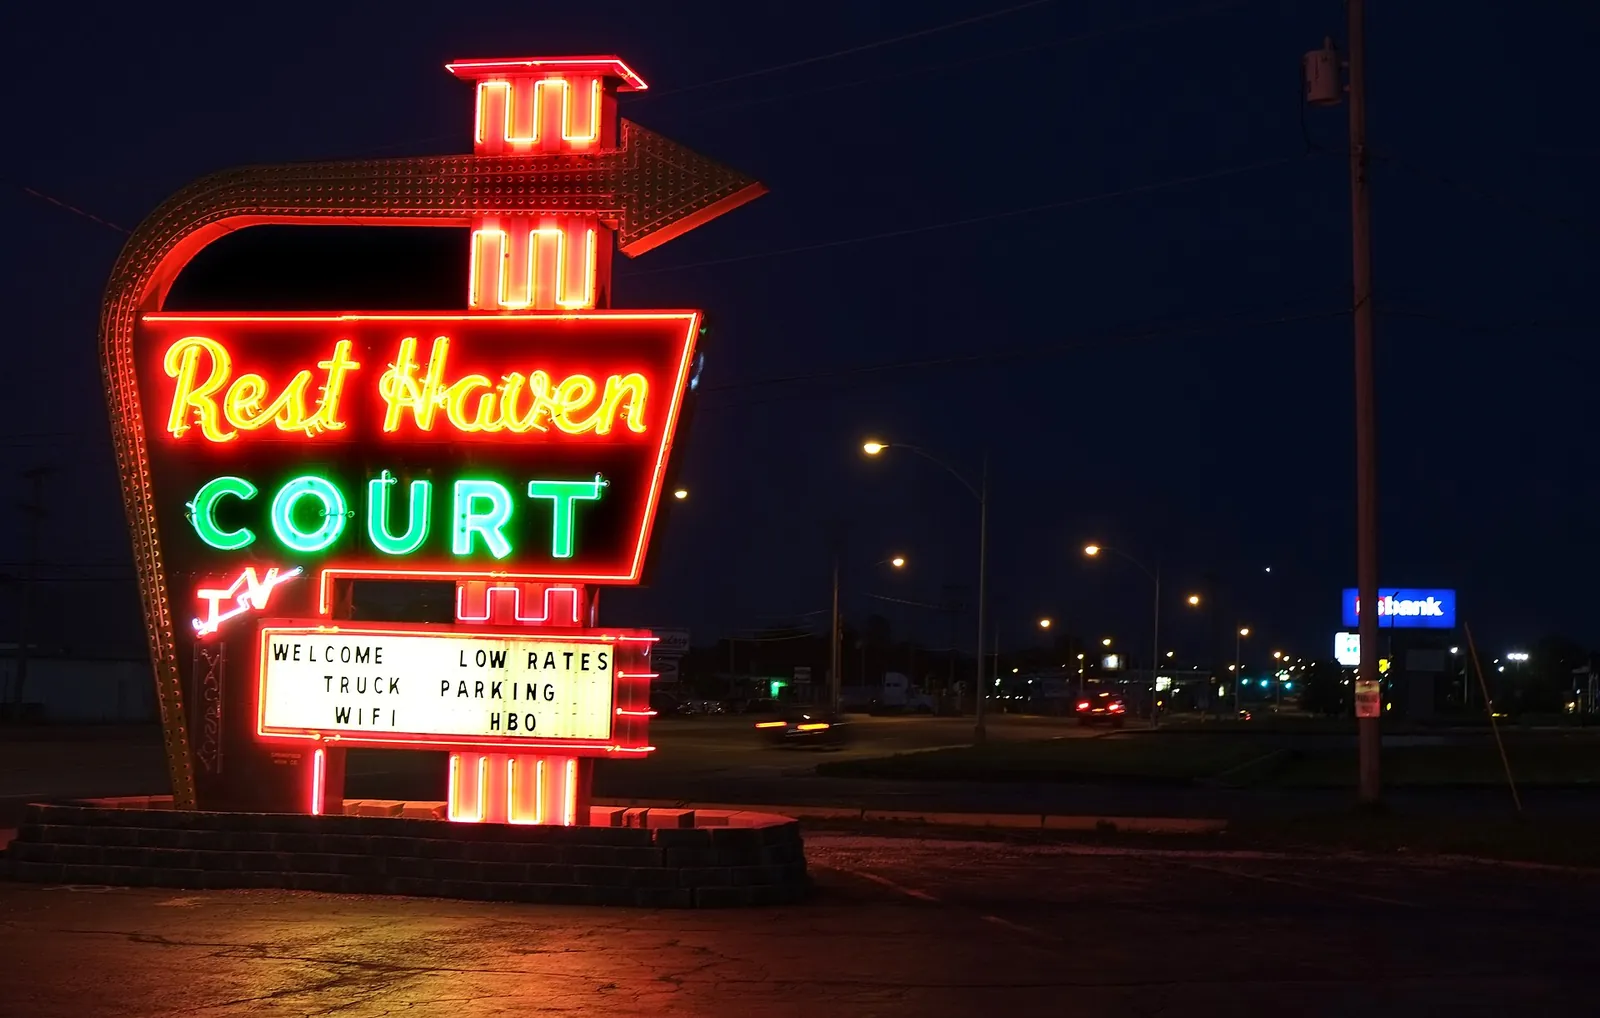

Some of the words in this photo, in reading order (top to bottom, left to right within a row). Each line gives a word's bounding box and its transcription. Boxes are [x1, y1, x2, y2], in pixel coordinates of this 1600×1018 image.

[164, 336, 361, 442] Rest
[379, 336, 648, 435] Haven
[189, 475, 602, 559] COURT
[197, 566, 280, 633] TV
[273, 643, 383, 664] WELCOME
[459, 649, 507, 669] LOW
[527, 652, 609, 671] RATES
[324, 675, 401, 695] TRUCK
[440, 679, 556, 702] PARKING
[335, 706, 396, 727] WIFI
[489, 712, 536, 732] HBO
